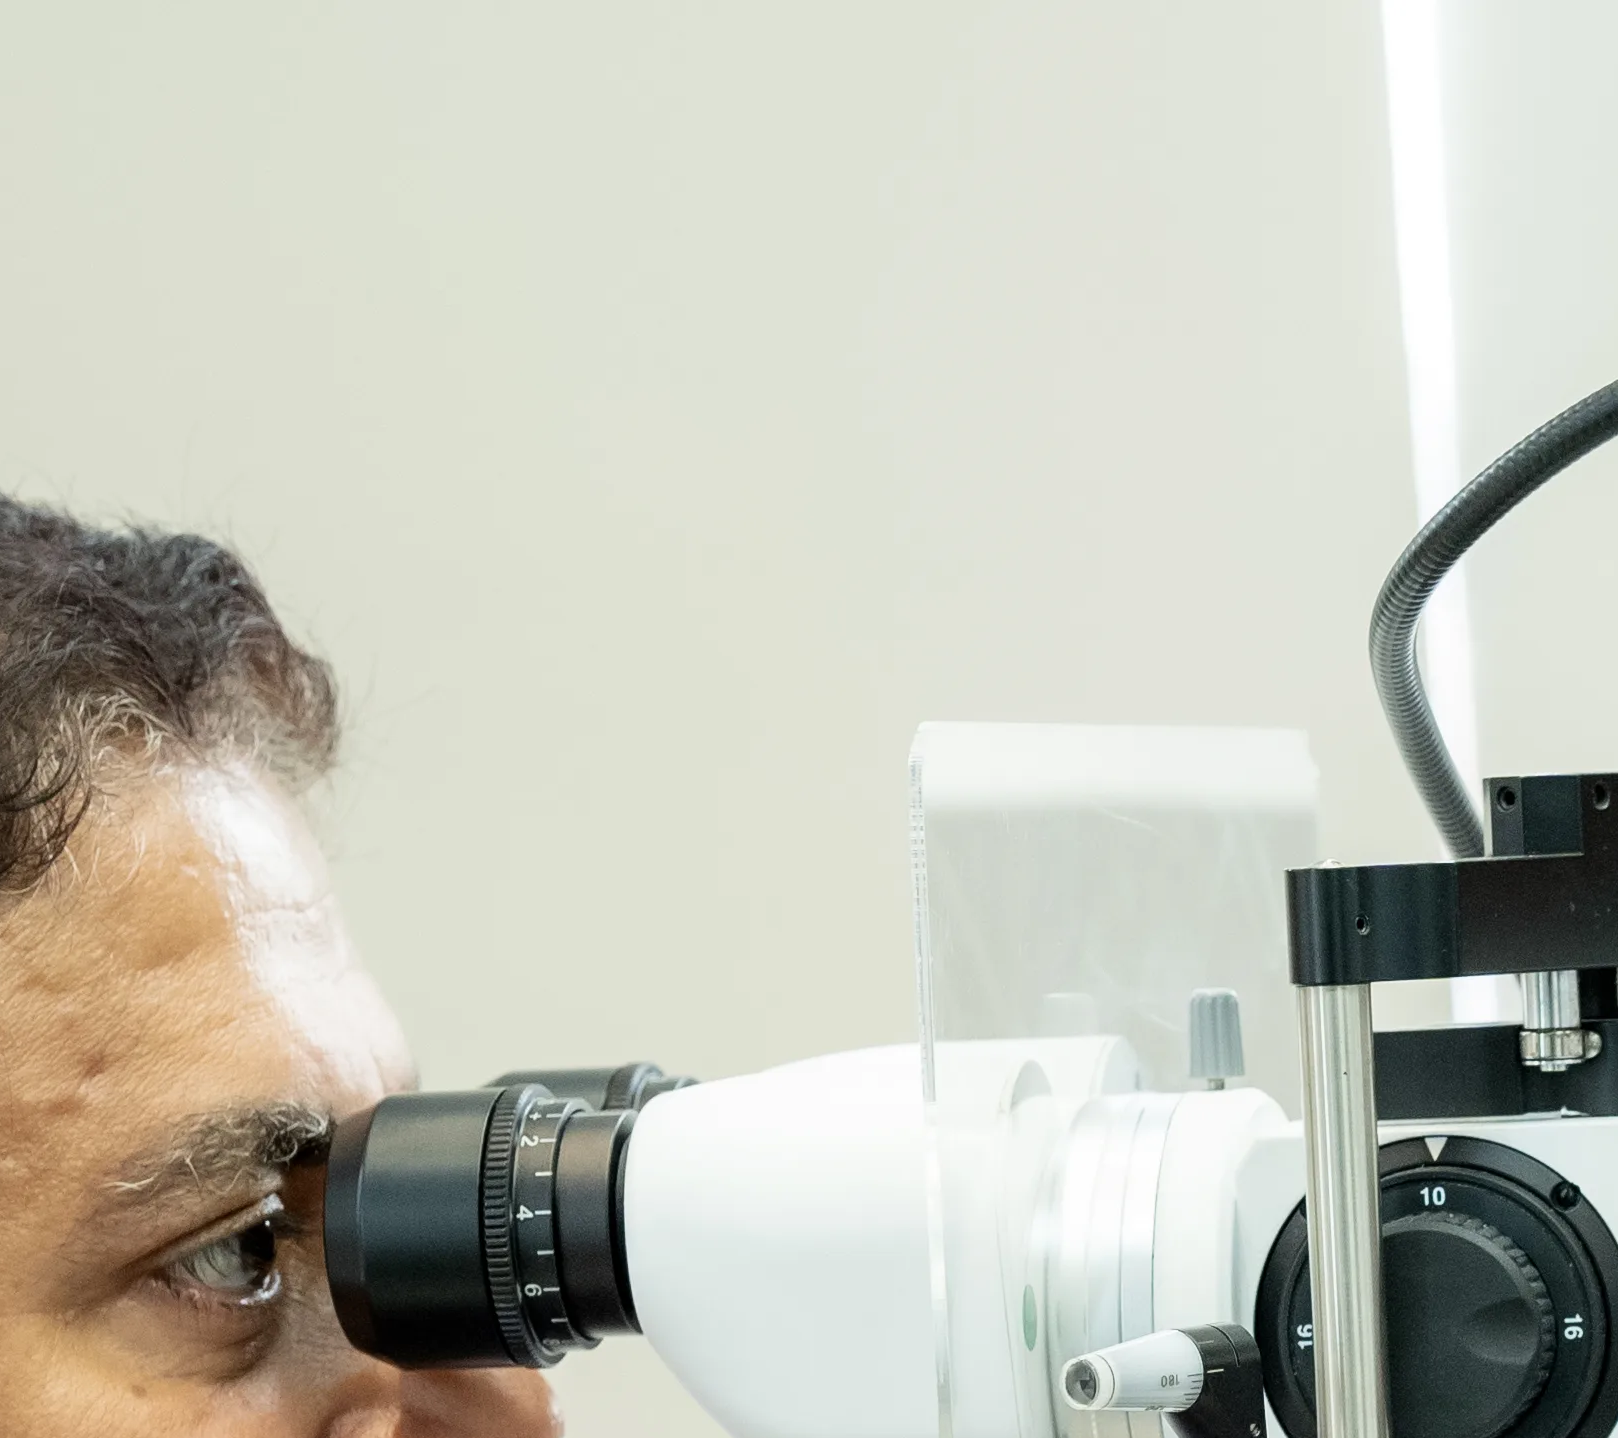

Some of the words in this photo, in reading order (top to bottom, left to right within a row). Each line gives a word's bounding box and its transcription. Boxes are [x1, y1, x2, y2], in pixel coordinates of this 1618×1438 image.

[520, 1134, 539, 1148] 2
[1419, 1186, 1446, 1206] 10
[516, 1204, 534, 1221] 4
[1563, 1313, 1584, 1341] 16
[1297, 1323, 1313, 1350] 16
[1161, 1374, 1180, 1388] 180
